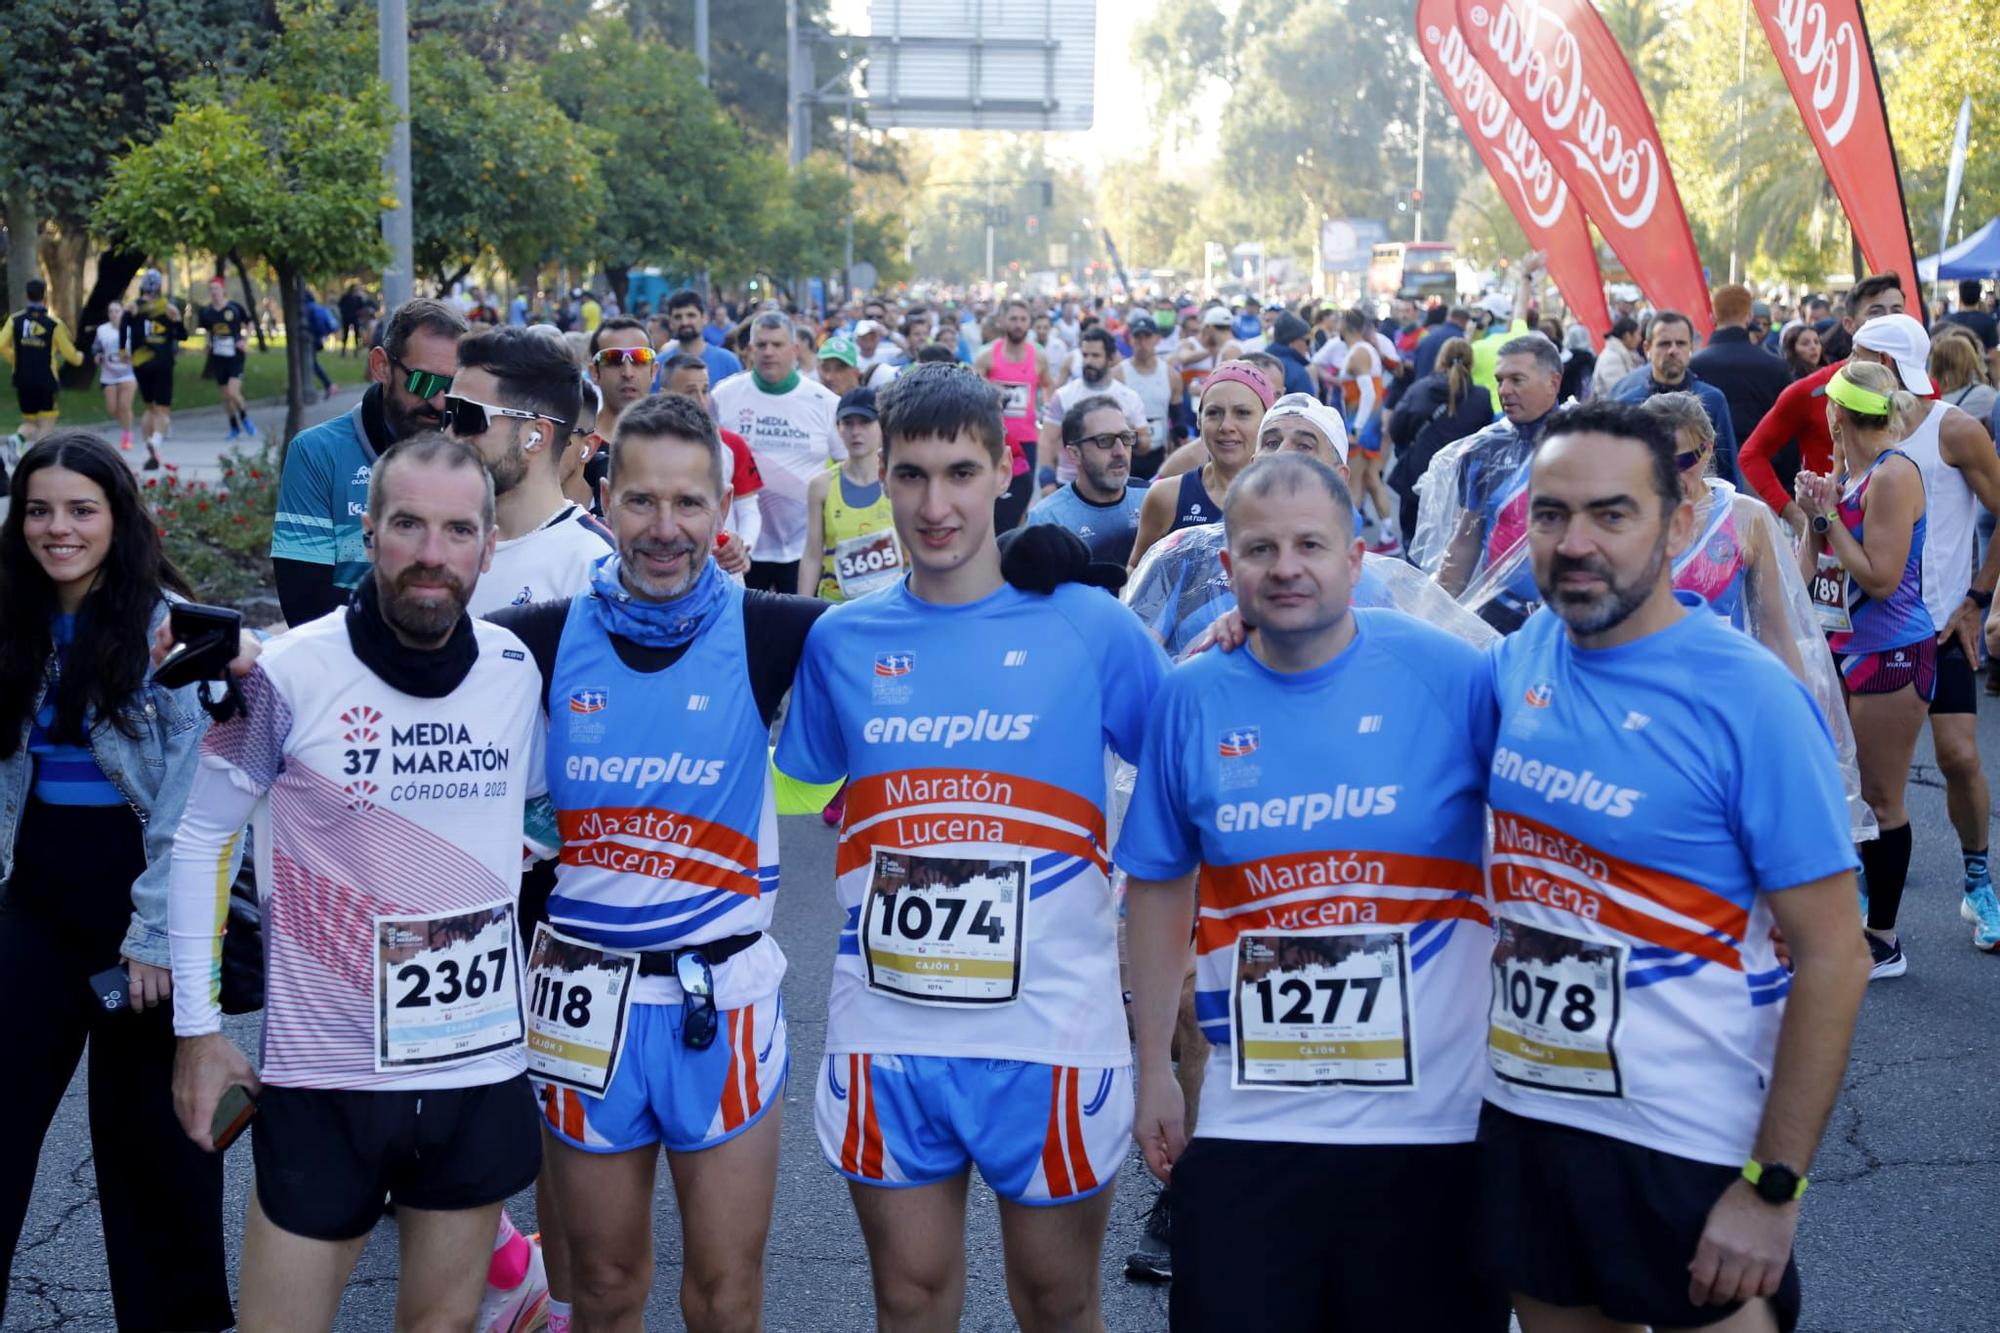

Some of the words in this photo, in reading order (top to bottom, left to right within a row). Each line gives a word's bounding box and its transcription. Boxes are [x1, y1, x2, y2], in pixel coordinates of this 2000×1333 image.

[756, 416, 789, 426] MEDIA
[1182, 514, 1207, 522] VIATOR
[841, 548, 896, 577] 3605
[391, 722, 472, 747] MEDIA
[864, 709, 1034, 749] enerplus
[343, 748, 381, 775] 37
[393, 741, 509, 775] MARATÓN
[566, 752, 726, 789] enerplus
[390, 781, 479, 802] CÓRDOBA
[484, 780, 508, 797] 2023
[885, 773, 1013, 806] Maratón
[1492, 747, 1641, 818] enerplus
[1216, 784, 1398, 833] enerplus
[578, 812, 693, 845] Maatón
[897, 817, 1005, 846] Lucena
[578, 847, 676, 879] Lucena
[1499, 817, 1610, 881] Maratón
[1245, 852, 1385, 897] Maratón
[1507, 866, 1601, 920] Lucena
[881, 895, 1005, 944] 1074
[396, 947, 508, 1009] 2367
[915, 960, 950, 971] CAJÓN
[530, 972, 593, 1029] 1118
[1256, 977, 1383, 1024] 1277
[1501, 965, 1597, 1033] 1078
